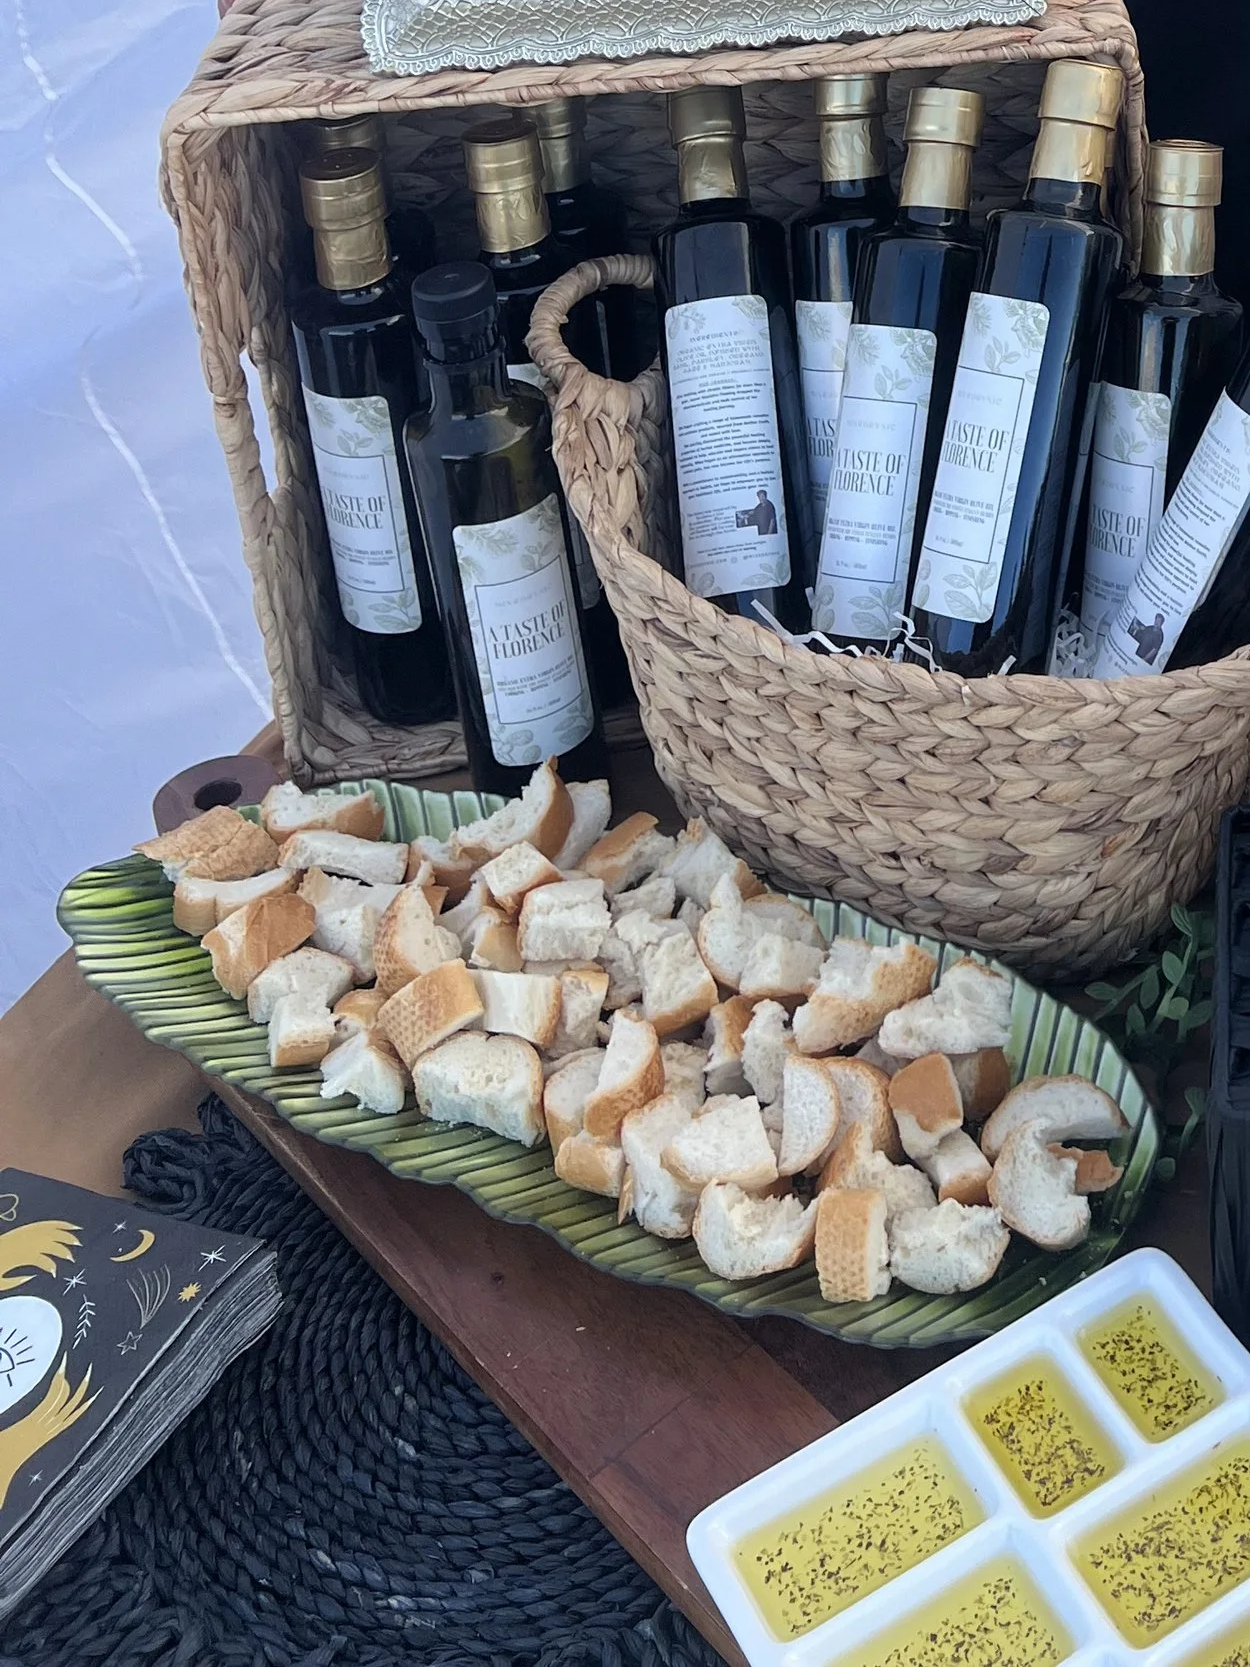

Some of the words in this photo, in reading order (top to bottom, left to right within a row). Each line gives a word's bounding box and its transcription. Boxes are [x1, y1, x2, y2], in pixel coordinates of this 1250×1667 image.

[813, 417, 837, 438] TAS
[951, 419, 987, 447] TASTE
[988, 428, 1010, 451] OF
[808, 437, 835, 458] FLOR
[941, 443, 998, 473] FLORENCE
[843, 448, 882, 474] TASTE
[885, 453, 907, 475] OF
[834, 469, 896, 496] FLORENCE
[327, 488, 365, 512] TASTE
[368, 496, 387, 513] OF
[1126, 515, 1145, 537] OF
[499, 610, 549, 641] TASTE
[551, 599, 565, 623] OF
[493, 622, 564, 660] FLORENCE
